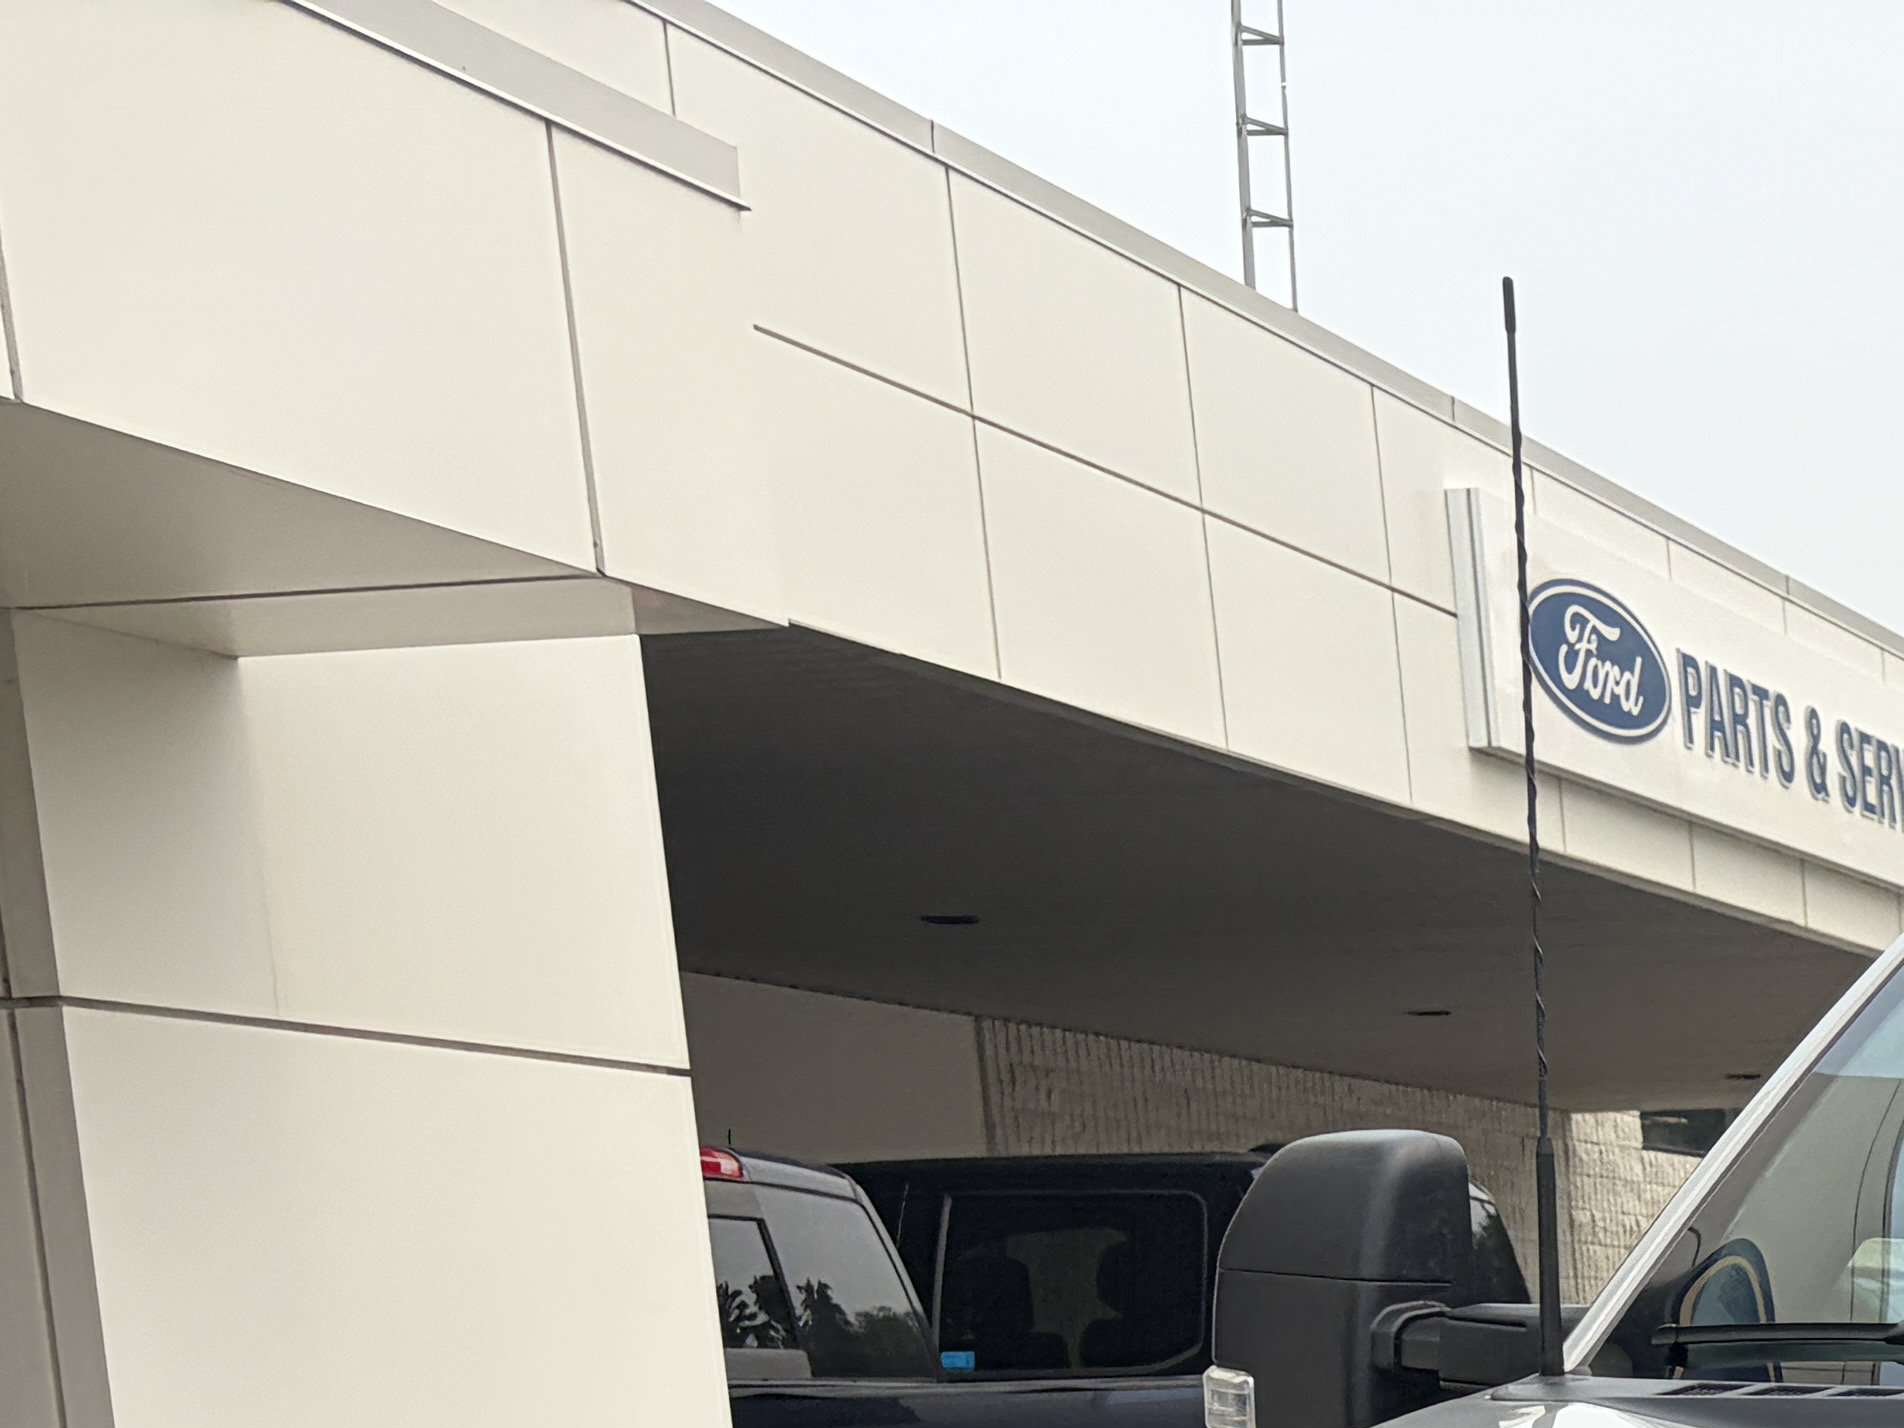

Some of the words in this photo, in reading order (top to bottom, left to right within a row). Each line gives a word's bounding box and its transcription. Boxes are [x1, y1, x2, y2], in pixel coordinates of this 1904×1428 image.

[1560, 605, 1643, 715] Ford
[1678, 649, 1796, 788] PARTS
[1805, 705, 1829, 801] &
